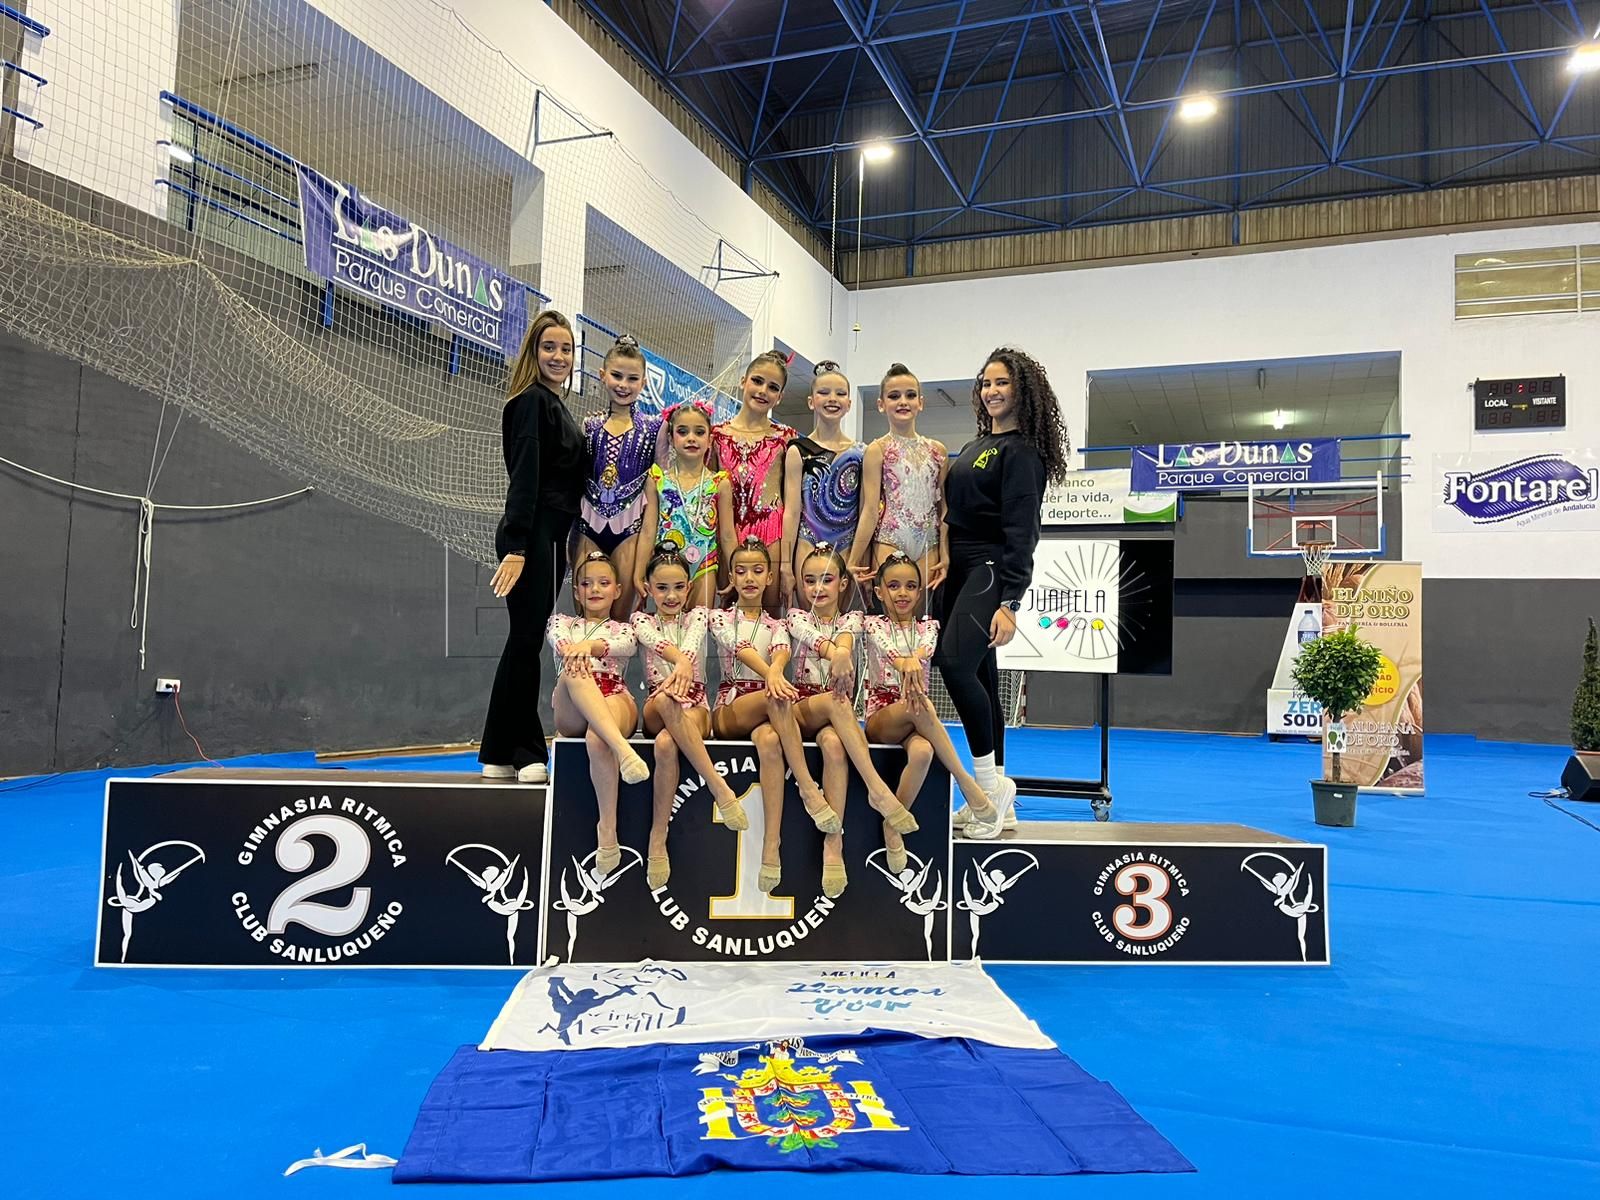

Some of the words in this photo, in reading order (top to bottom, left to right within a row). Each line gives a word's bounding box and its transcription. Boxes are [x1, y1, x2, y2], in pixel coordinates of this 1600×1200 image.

[336, 250, 406, 300] Parque
[416, 288, 500, 341] Comercial
[1484, 399, 1509, 408] LOCAL
[1532, 397, 1557, 406] VISITANTE
[1159, 471, 1214, 486] Parque
[1223, 468, 1309, 483] Comercial
[1444, 468, 1599, 505] Fontarel
[1048, 507, 1112, 521] deporte...
[1067, 492, 1078, 503] la
[1082, 491, 1114, 504] vida,
[1027, 589, 1106, 613] JUANELA
[1332, 588, 1357, 603] EL
[1360, 585, 1413, 604] NIÑO
[1336, 603, 1364, 618] DE
[1367, 605, 1410, 619] ORO
[1283, 713, 1322, 727] SODI
[1288, 701, 1321, 714] ZER
[238, 796, 332, 865] GIMNASIA
[341, 798, 406, 867] RITMICA
[709, 782, 794, 919] 1
[267, 814, 371, 936] 2
[1093, 852, 1144, 895] GIMNASIA
[1149, 853, 1189, 896] RITMICA
[648, 882, 690, 931] LUB
[692, 893, 841, 956] SANLUQUEÑ
[1113, 863, 1172, 940] 3
[232, 892, 268, 942] CLUB
[270, 902, 403, 962] SANLUQUEÑO
[1092, 911, 1114, 942] CLUB
[1116, 917, 1190, 955] SANLUQUEÑO
